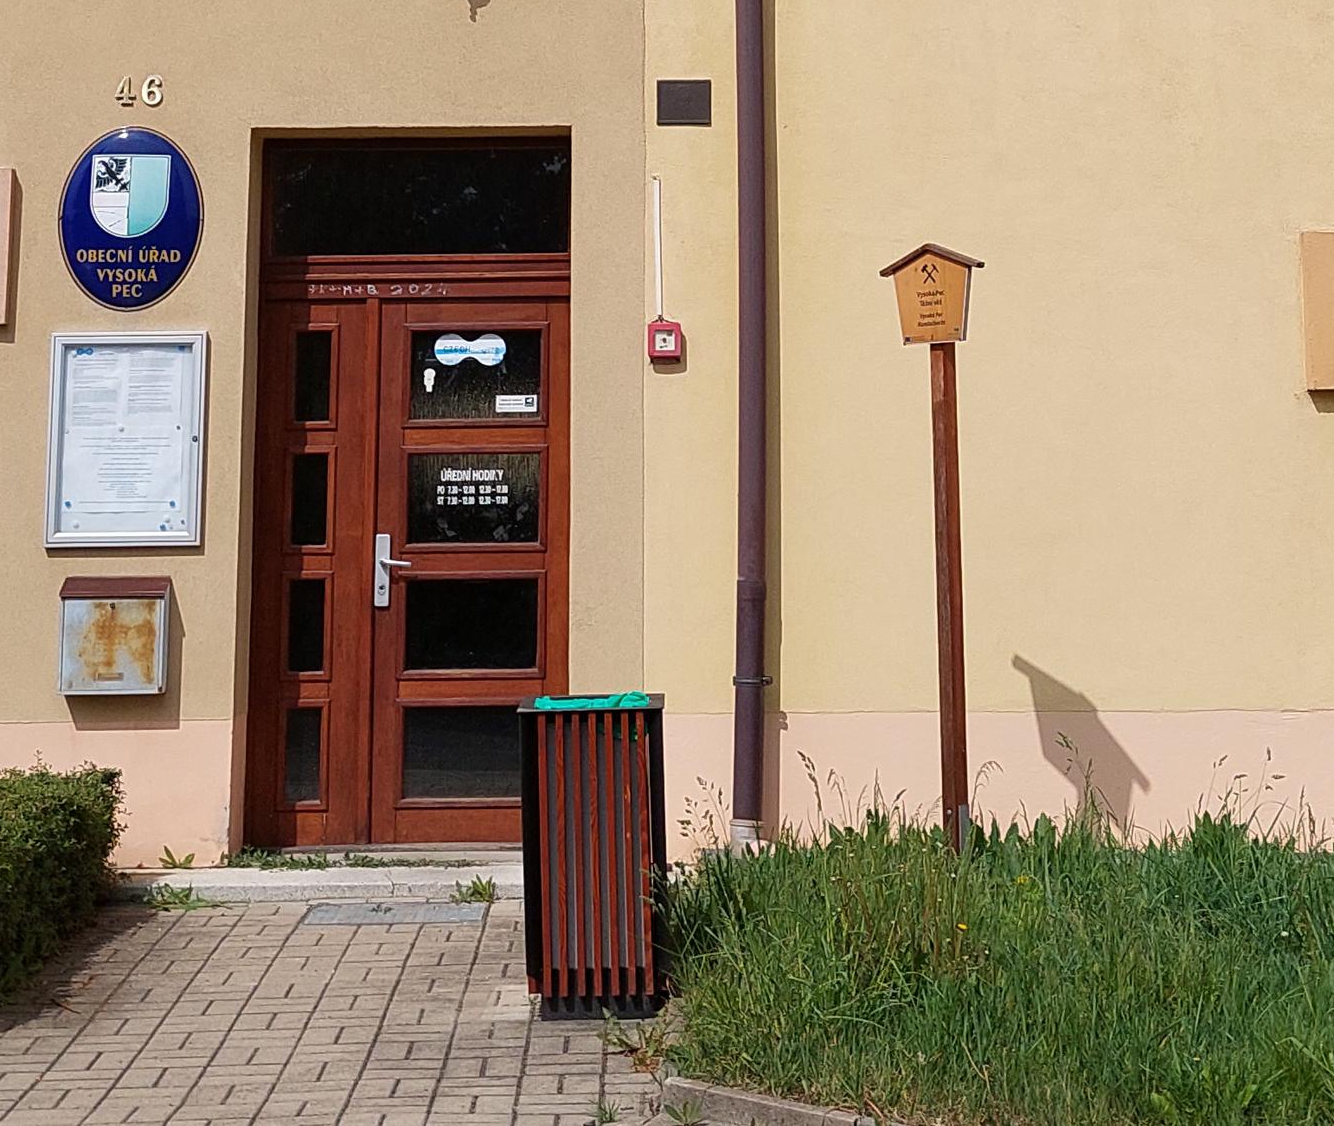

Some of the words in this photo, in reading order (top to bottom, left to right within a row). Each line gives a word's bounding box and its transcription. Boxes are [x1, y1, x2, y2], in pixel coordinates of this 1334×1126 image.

[114, 74, 163, 108] 46
[76, 245, 133, 263] OBECNÍ
[138, 245, 181, 263] ÚŘAD
[96, 265, 158, 282] VYSOKÁ
[112, 284, 143, 298] PEC
[440, 467, 472, 482] ÚŘEDNÍ
